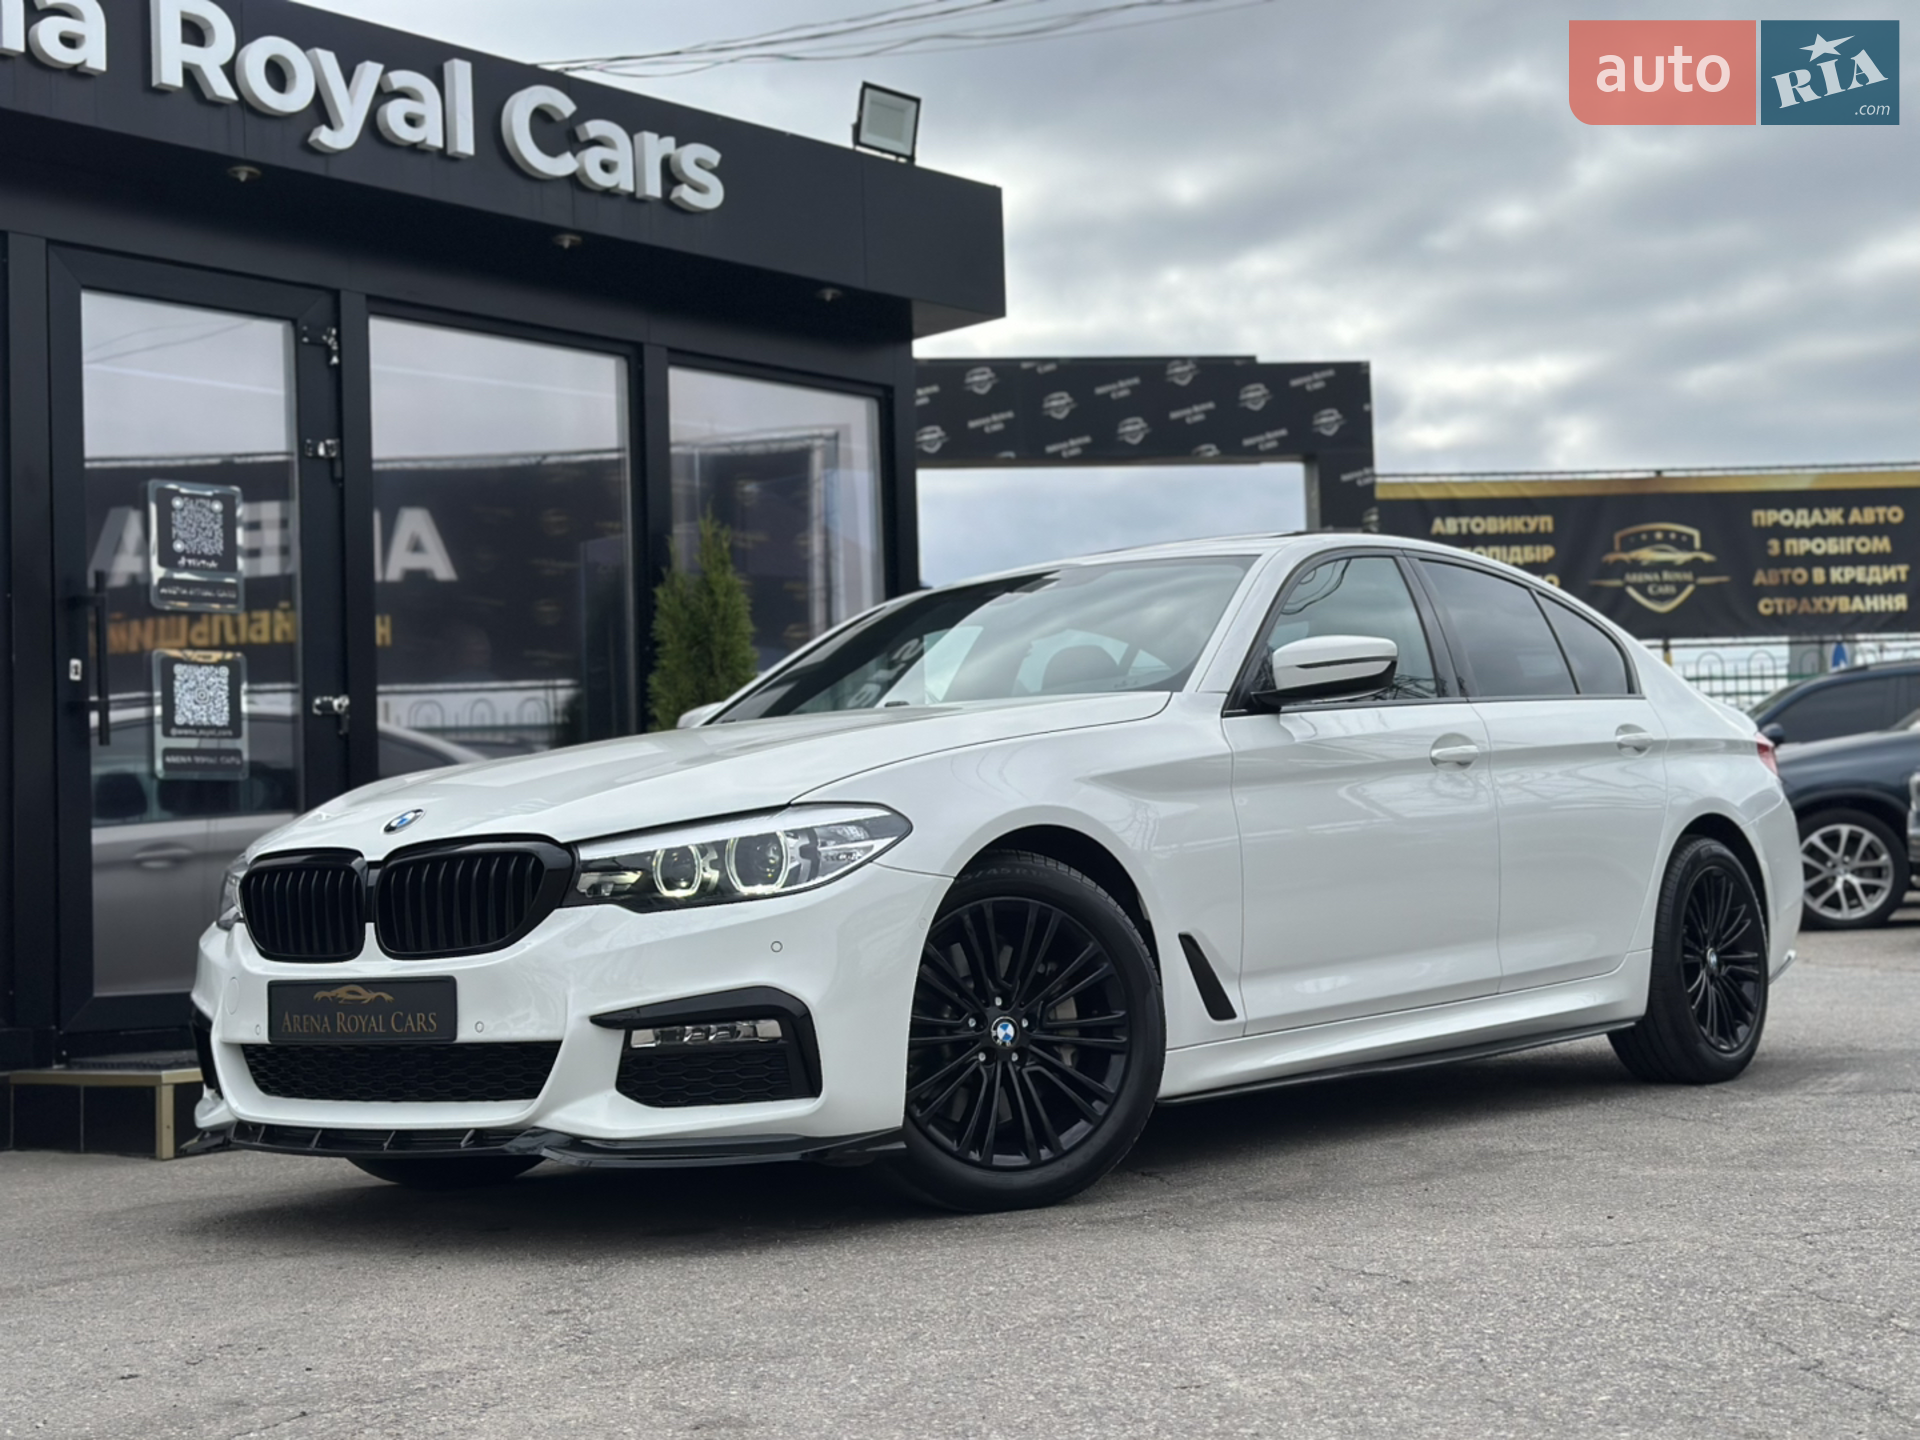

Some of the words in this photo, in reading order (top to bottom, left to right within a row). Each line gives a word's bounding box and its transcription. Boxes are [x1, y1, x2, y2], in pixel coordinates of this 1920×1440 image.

[151, 0, 475, 158] Royal
[501, 84, 724, 212] Cars
[1430, 514, 1554, 535] АВТОВИКУП
[1752, 508, 1844, 528] ПРОДАЖ
[1848, 505, 1904, 524] АВТО
[1784, 535, 1892, 556] ПРОБІГОМ
[1753, 567, 1809, 586] АВТО
[1812, 566, 1826, 584] В
[1829, 563, 1910, 585] КРЕДИТ
[1757, 593, 1908, 615] СТРАХУВАННЯ
[282, 1011, 331, 1033] ARENA
[337, 1011, 386, 1033] ROYAL
[391, 1011, 437, 1033] CARS
